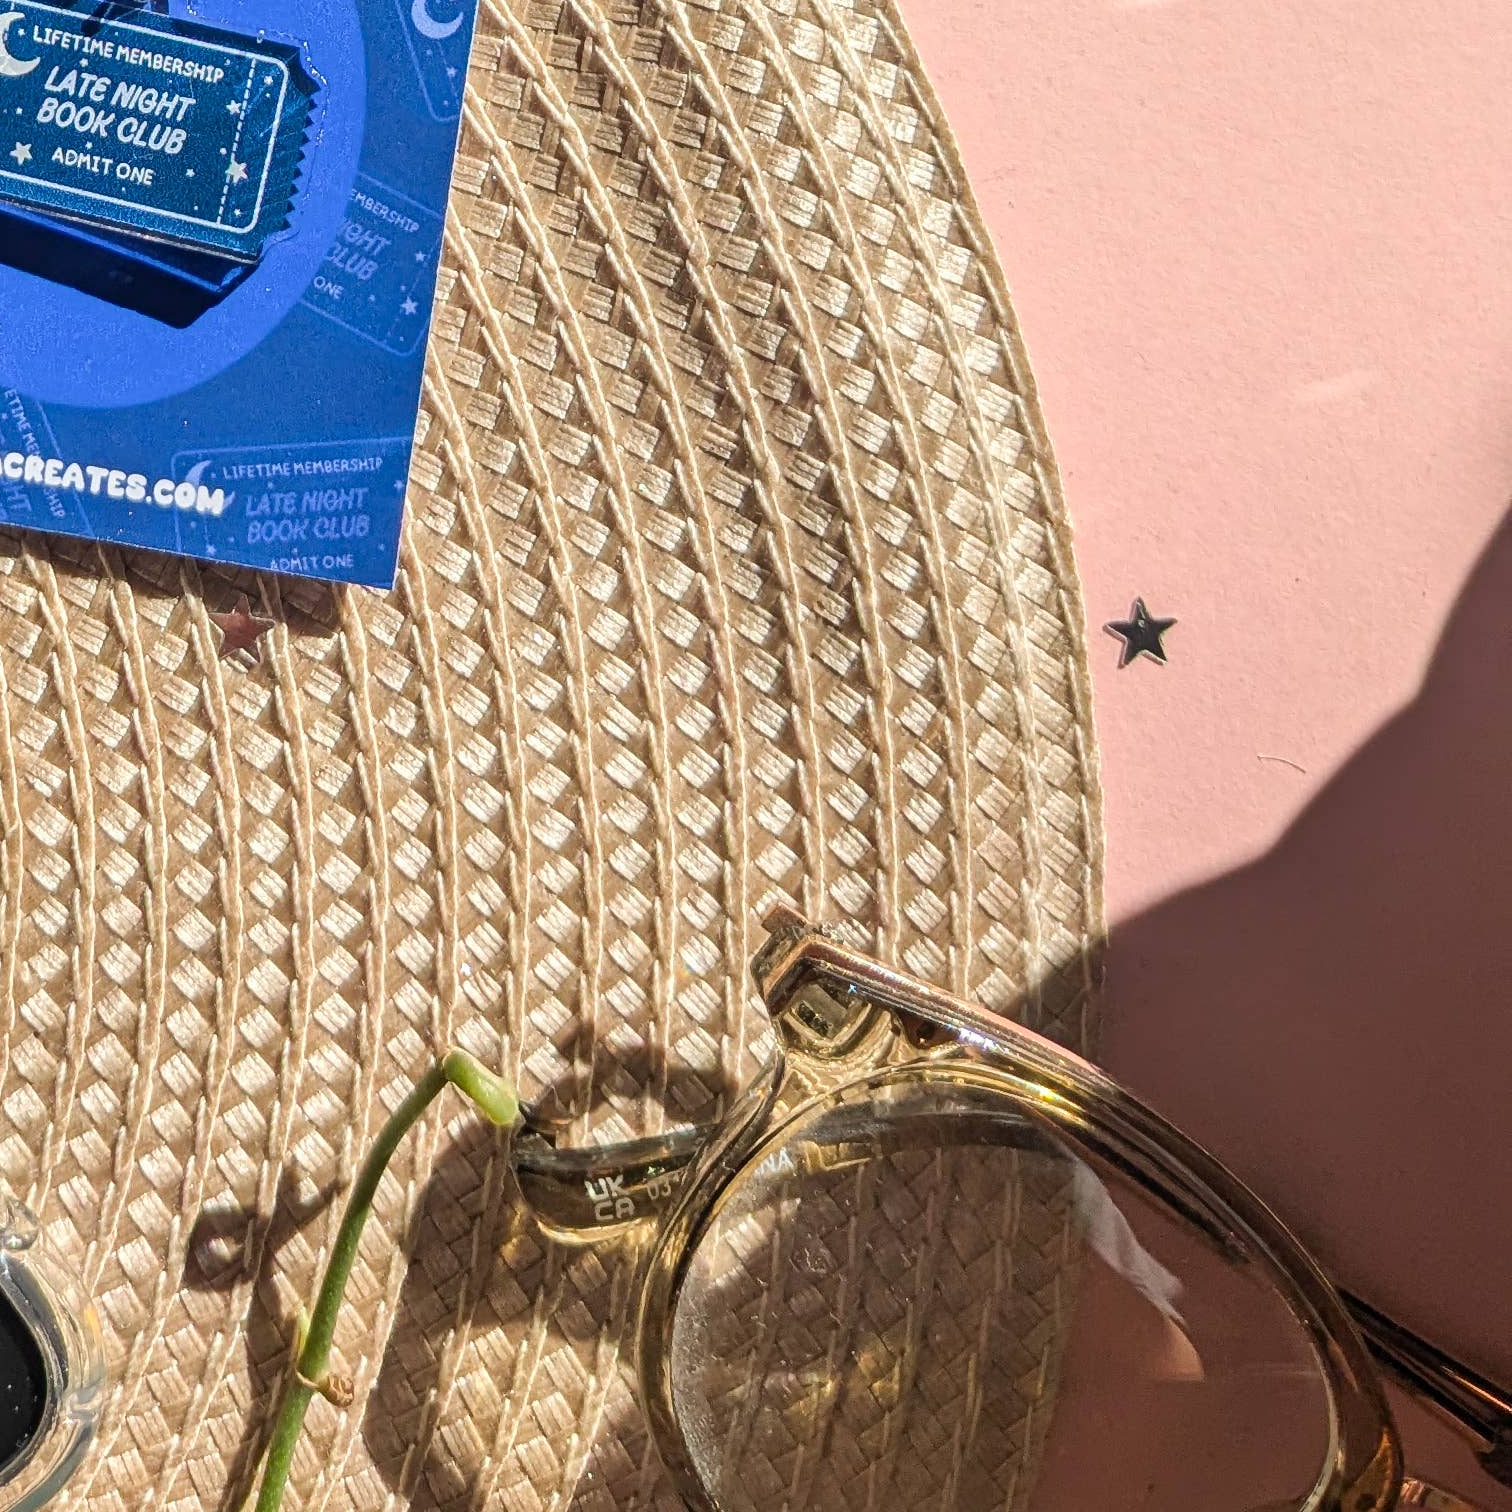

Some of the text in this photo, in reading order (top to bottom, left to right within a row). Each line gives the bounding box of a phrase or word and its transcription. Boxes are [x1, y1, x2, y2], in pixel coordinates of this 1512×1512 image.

[33, 24, 225, 84] LIFETIME MEMBERSHIP
[44, 66, 196, 121] LATE NIGHT
[37, 97, 188, 154] BOOK CLUB
[51, 147, 156, 186] ADMIT ONE
[313, 275, 345, 299] ONE
[223, 457, 383, 480] LIFETIME MEMBERSHIP
[246, 488, 370, 517] LATE NIGHT
[247, 514, 371, 545] BOOK CLUB
[322, 553, 354, 569] ONE
[584, 1174, 629, 1202] UK
[595, 1199, 636, 1223] CA
